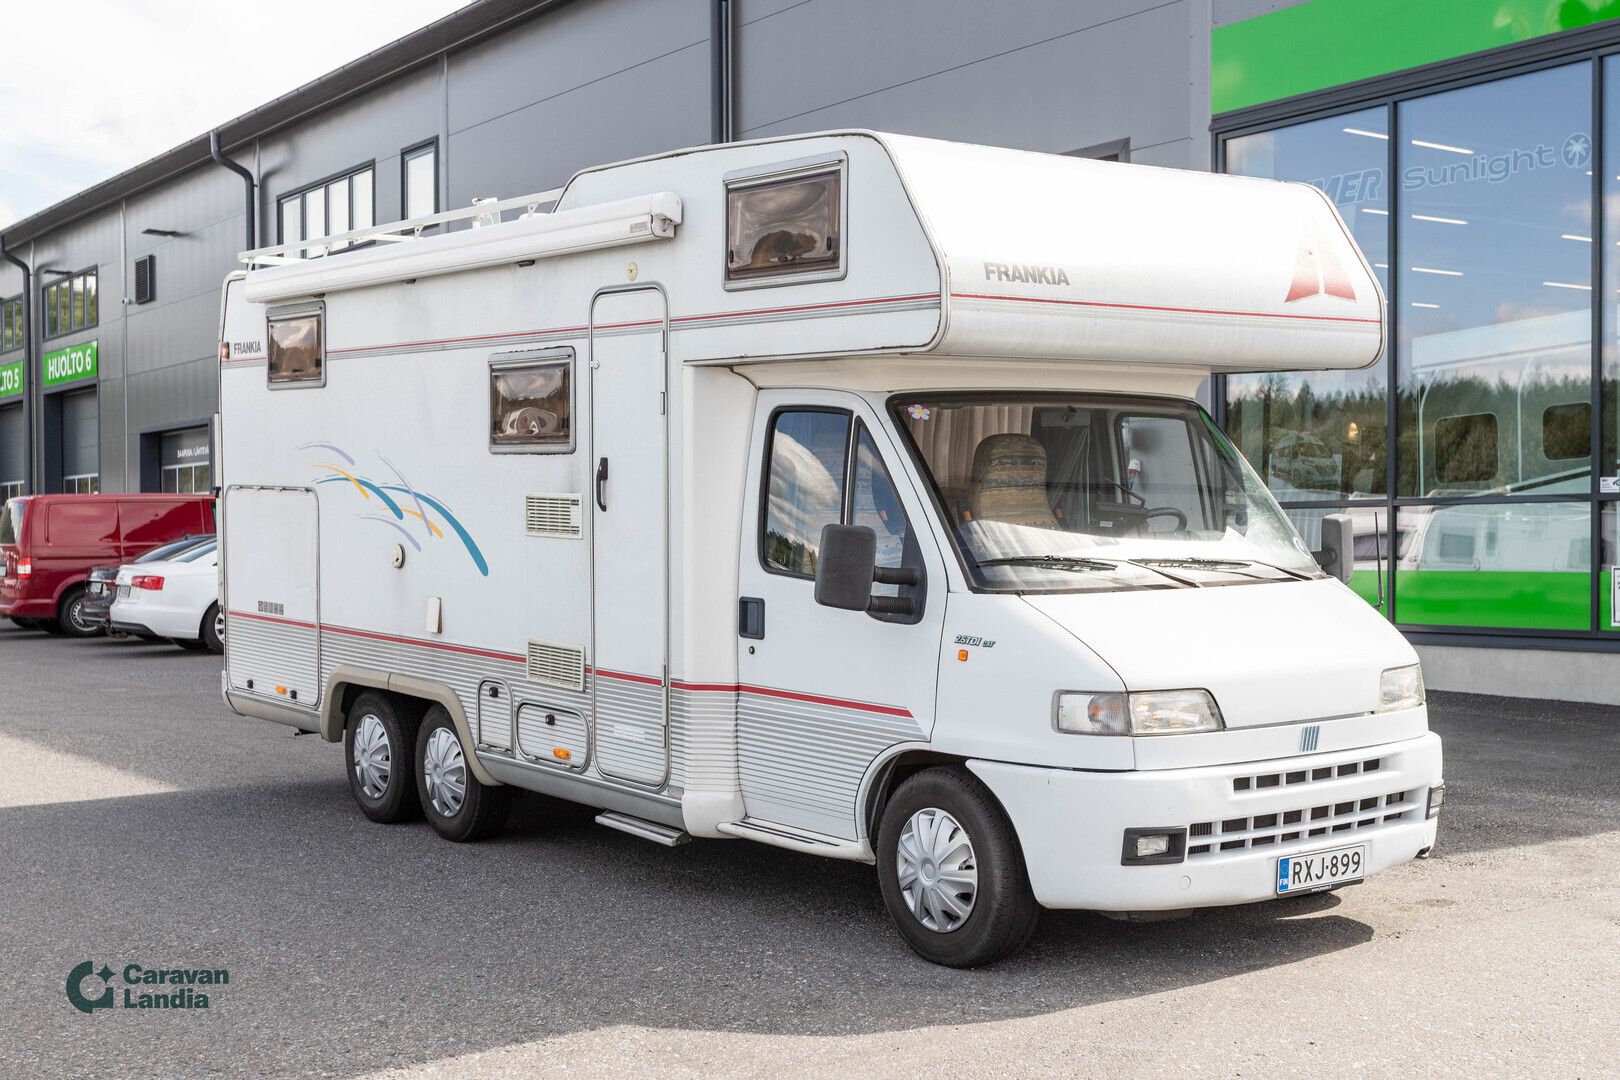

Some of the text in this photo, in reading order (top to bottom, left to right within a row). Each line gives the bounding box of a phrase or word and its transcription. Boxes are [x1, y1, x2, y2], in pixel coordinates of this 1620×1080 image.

[1402, 144, 1556, 191] Sunlight
[983, 262, 1071, 286] FRANKIA
[233, 340, 262, 355] FRANKIA
[14, 367, 19, 389] 5
[48, 348, 92, 380] HUOLTO 6
[1292, 851, 1361, 885] RXJ-899
